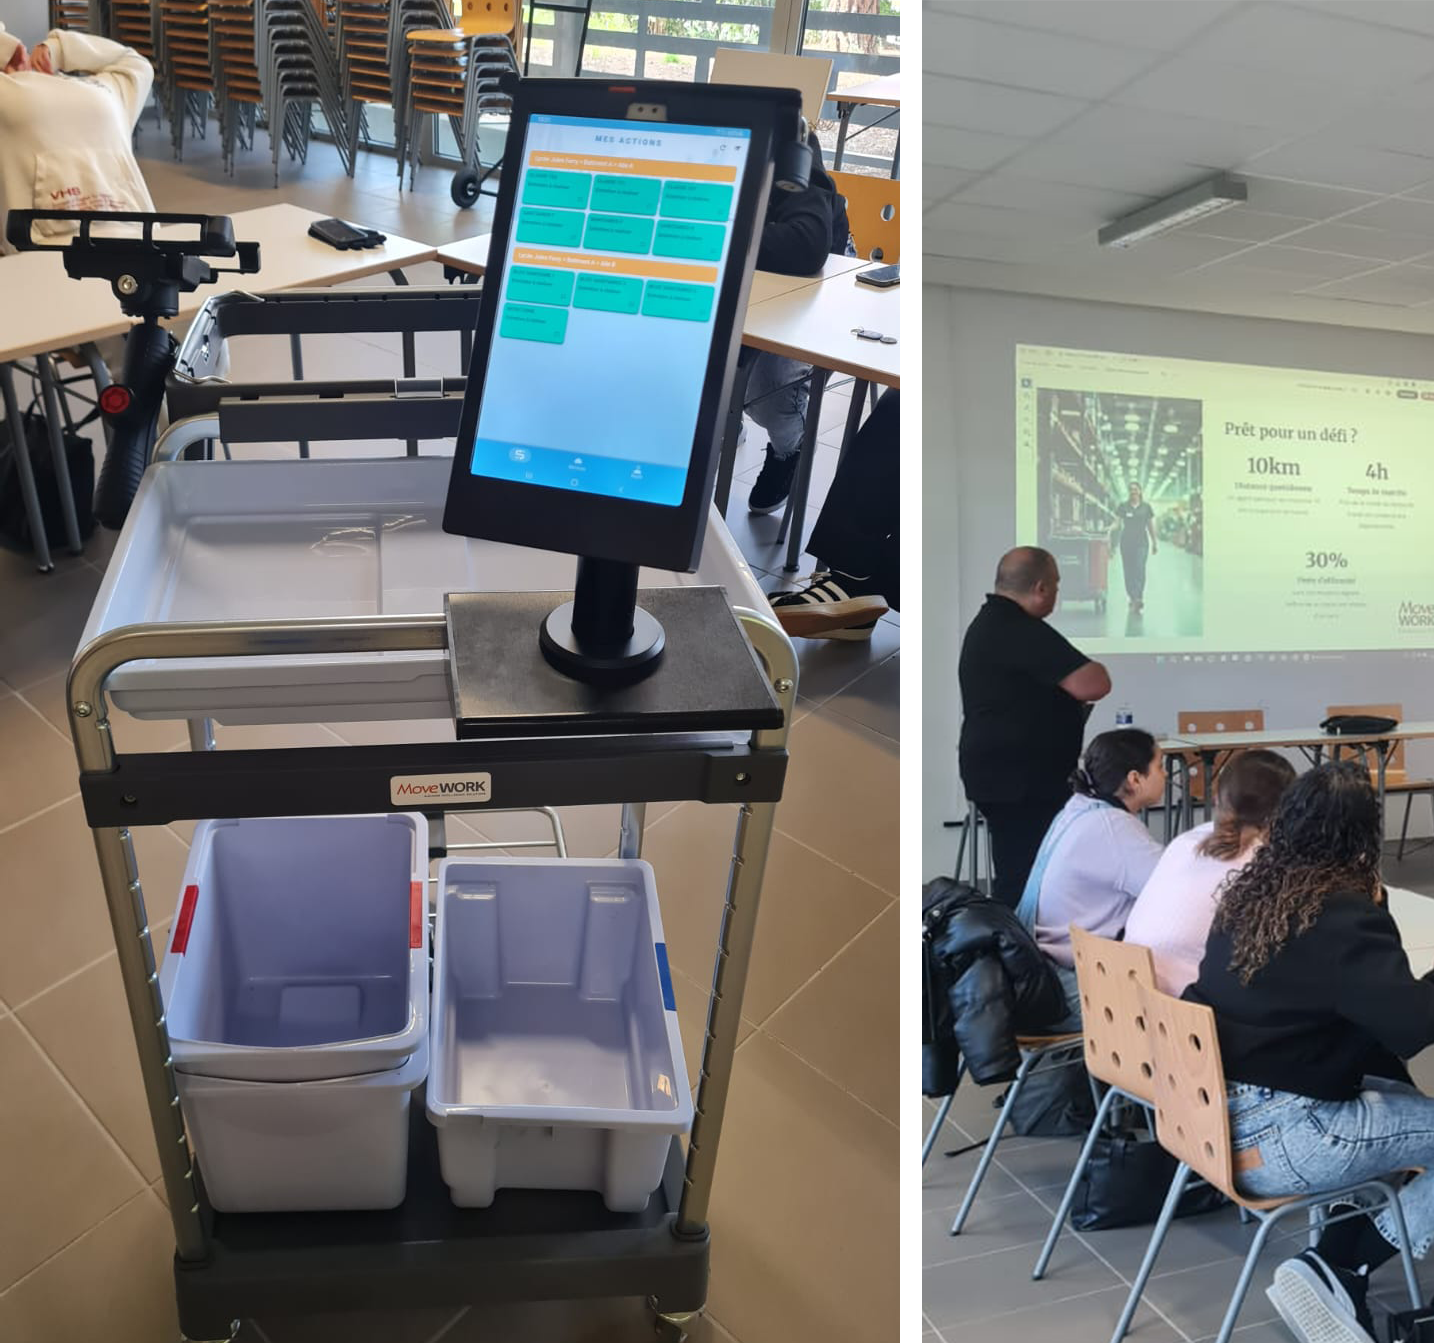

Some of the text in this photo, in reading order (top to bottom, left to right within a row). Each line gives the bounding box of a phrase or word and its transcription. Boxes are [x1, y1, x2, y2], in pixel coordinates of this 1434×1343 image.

[595, 134, 663, 147] MES ACTIONS
[1224, 421, 1358, 443] Prêt pour un défi ?
[1247, 456, 1301, 476] 10km
[1365, 461, 1389, 480] 4h
[1305, 551, 1348, 569] 30%
